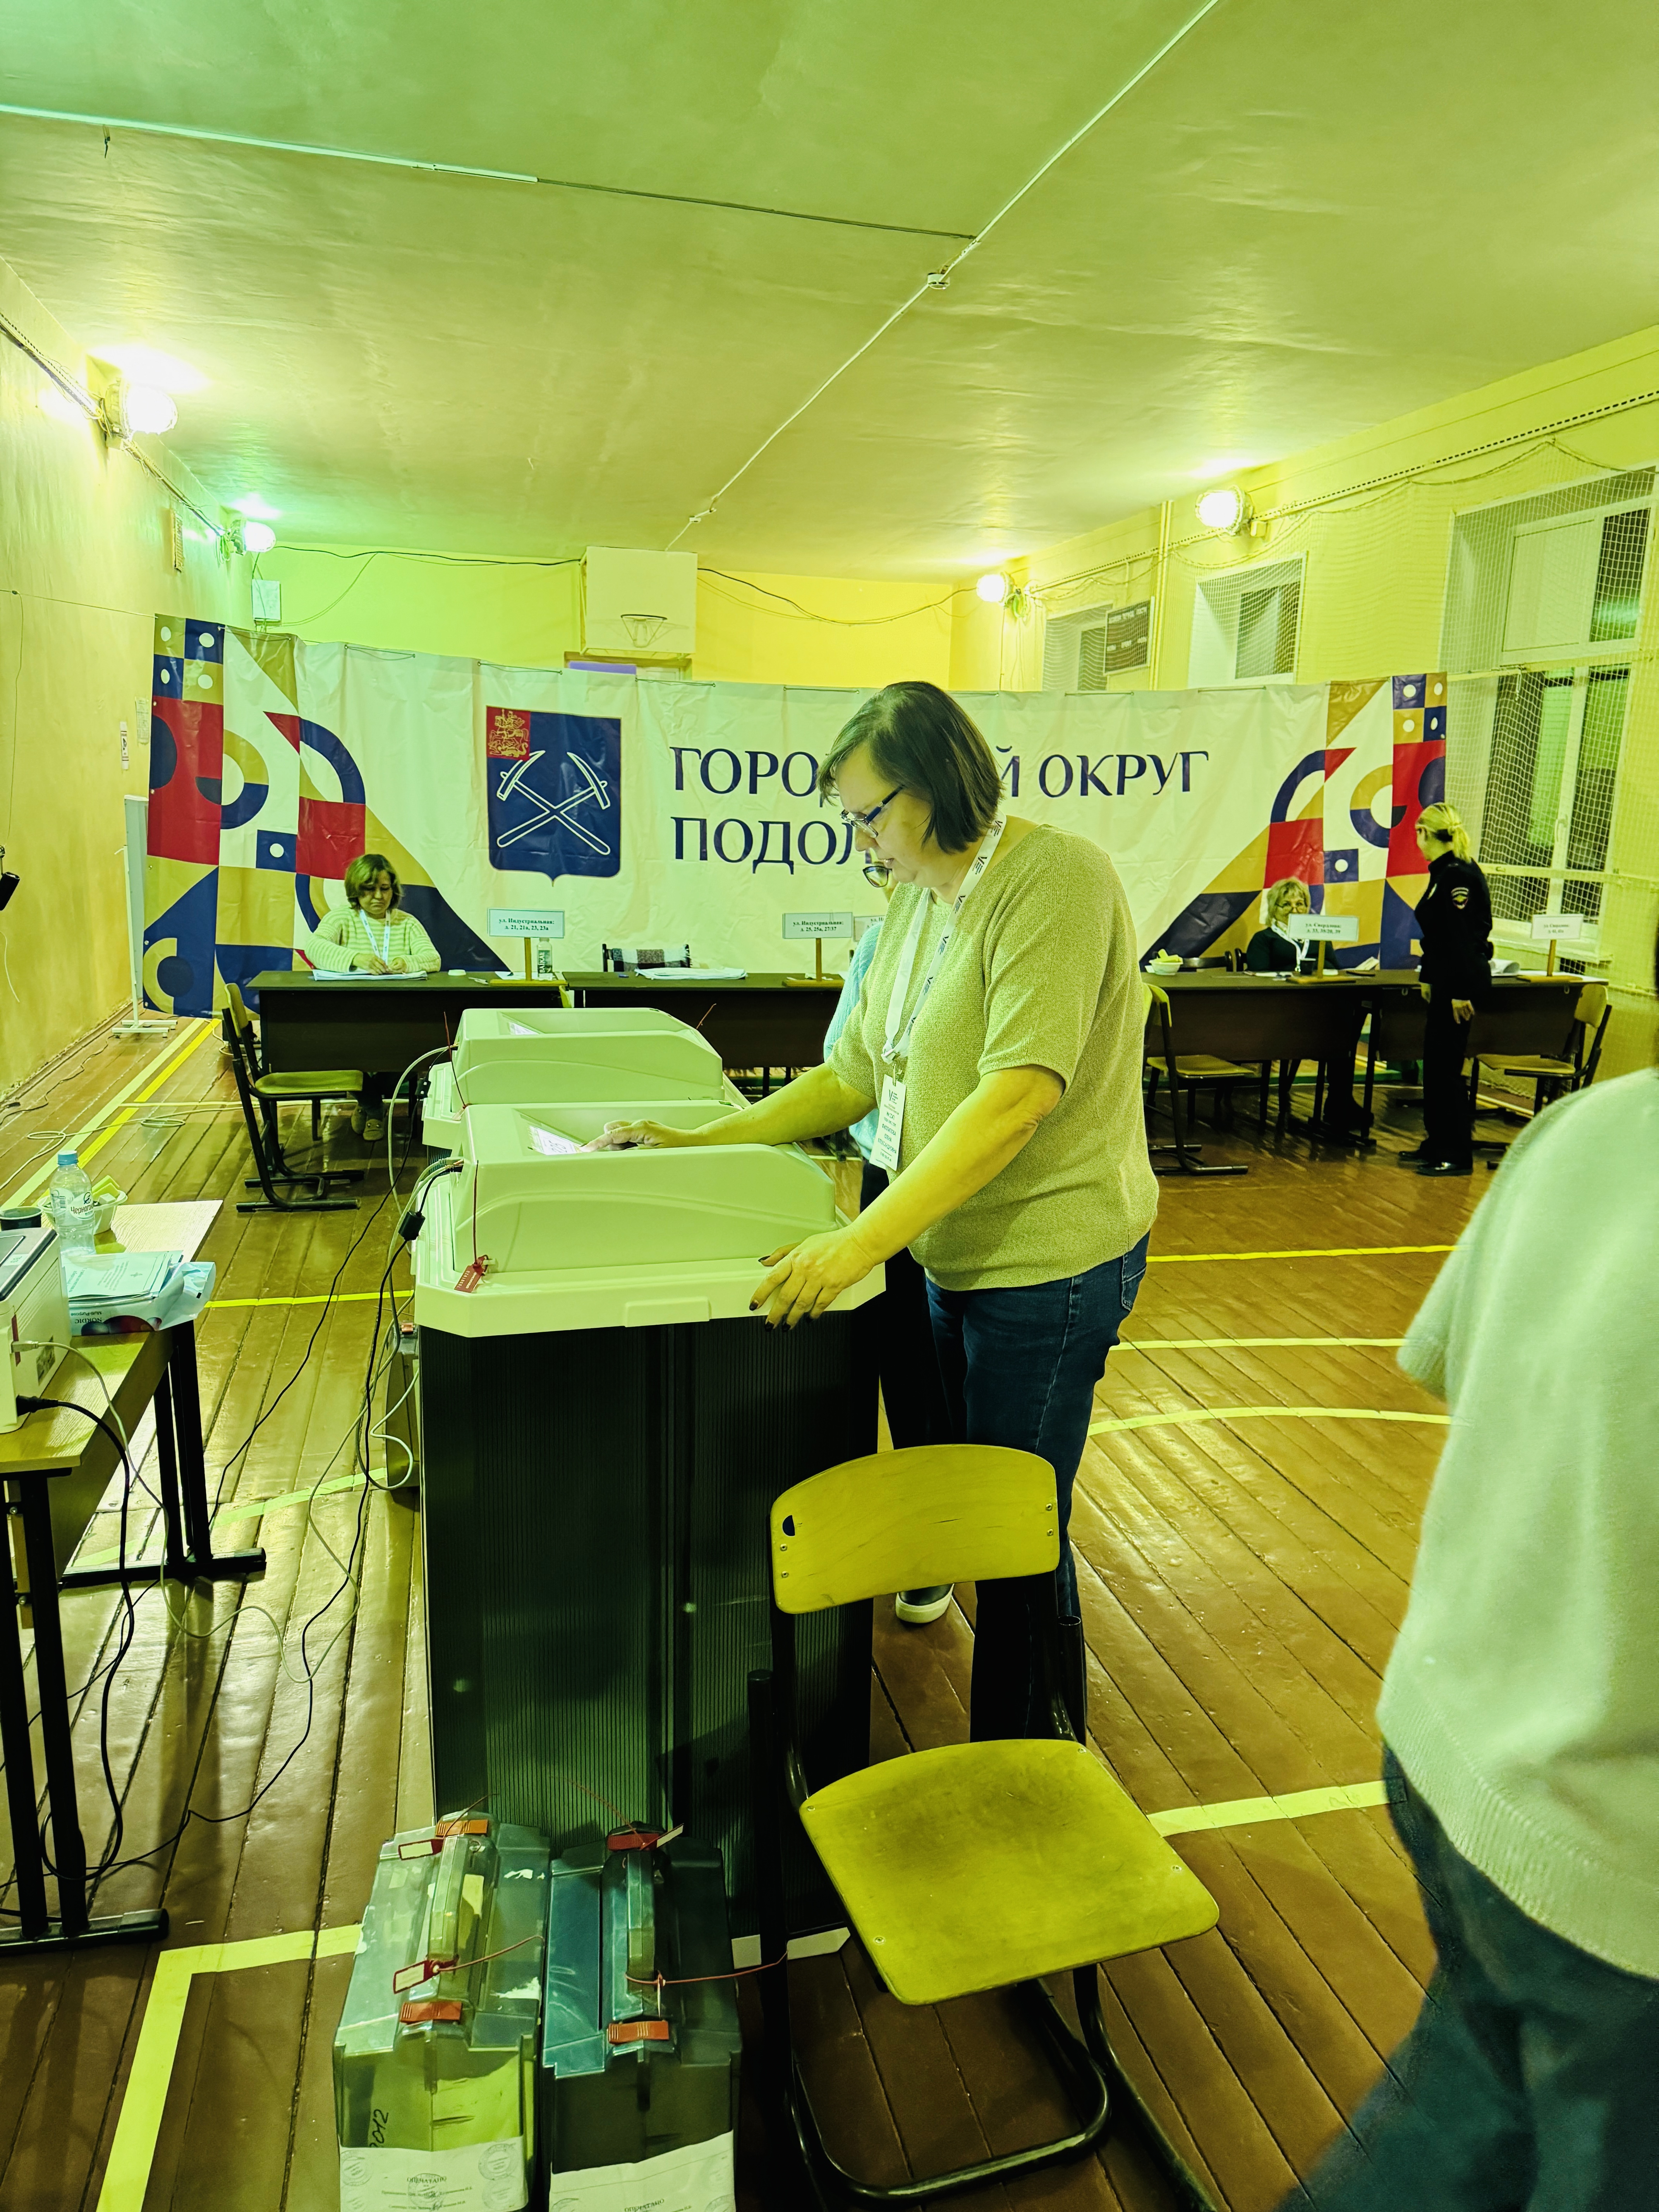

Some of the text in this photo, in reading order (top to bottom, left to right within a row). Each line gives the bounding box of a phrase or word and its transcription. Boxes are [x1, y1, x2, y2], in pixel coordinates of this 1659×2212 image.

[670, 746, 1209, 807] ГОРОЙ ОКРУГ
[670, 817, 872, 875] ПОДОЛ
[624, 2198, 665, 2212] ОПЕЧАТАНО
